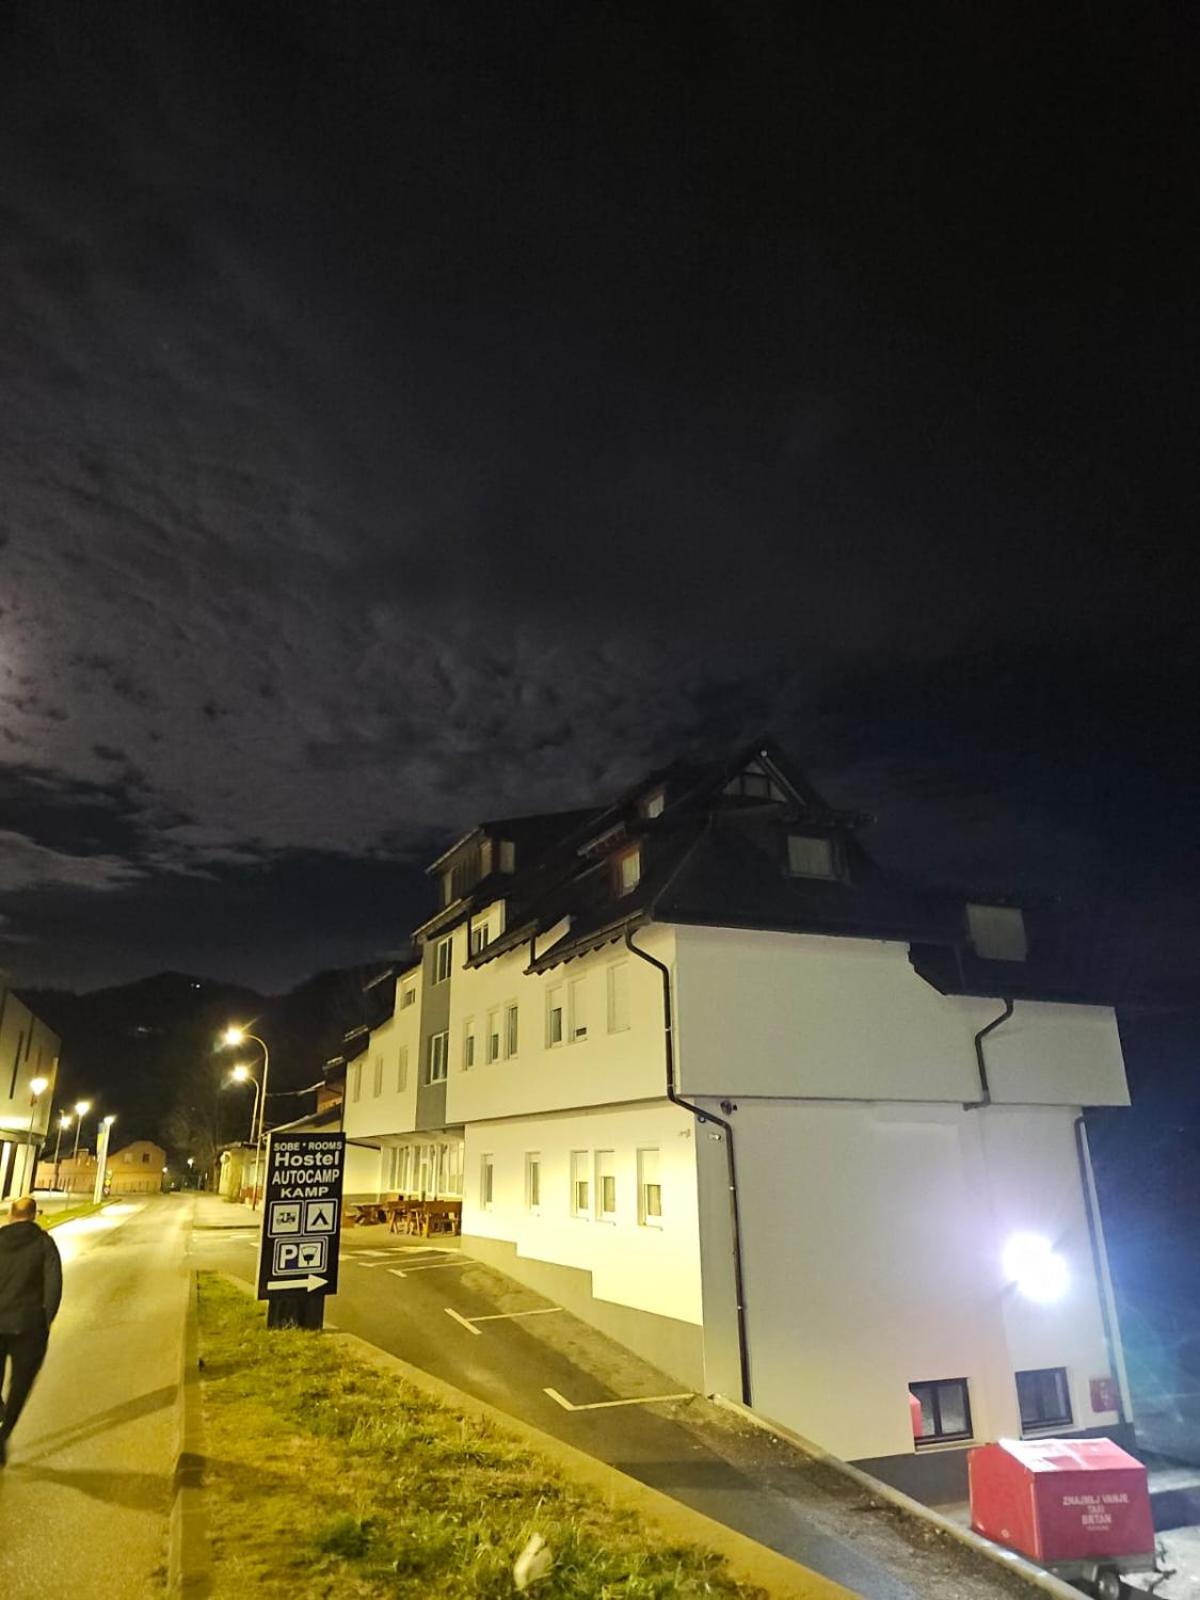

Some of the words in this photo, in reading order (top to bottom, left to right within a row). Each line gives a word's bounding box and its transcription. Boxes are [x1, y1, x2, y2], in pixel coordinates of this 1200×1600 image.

[273, 1142, 300, 1152] SOBE
[308, 1141, 343, 1151] ROOMS
[274, 1150, 340, 1167] Hostel
[272, 1169, 340, 1185] AUTOCAMP
[281, 1186, 329, 1198] KAMP
[280, 1244, 298, 1269] P
